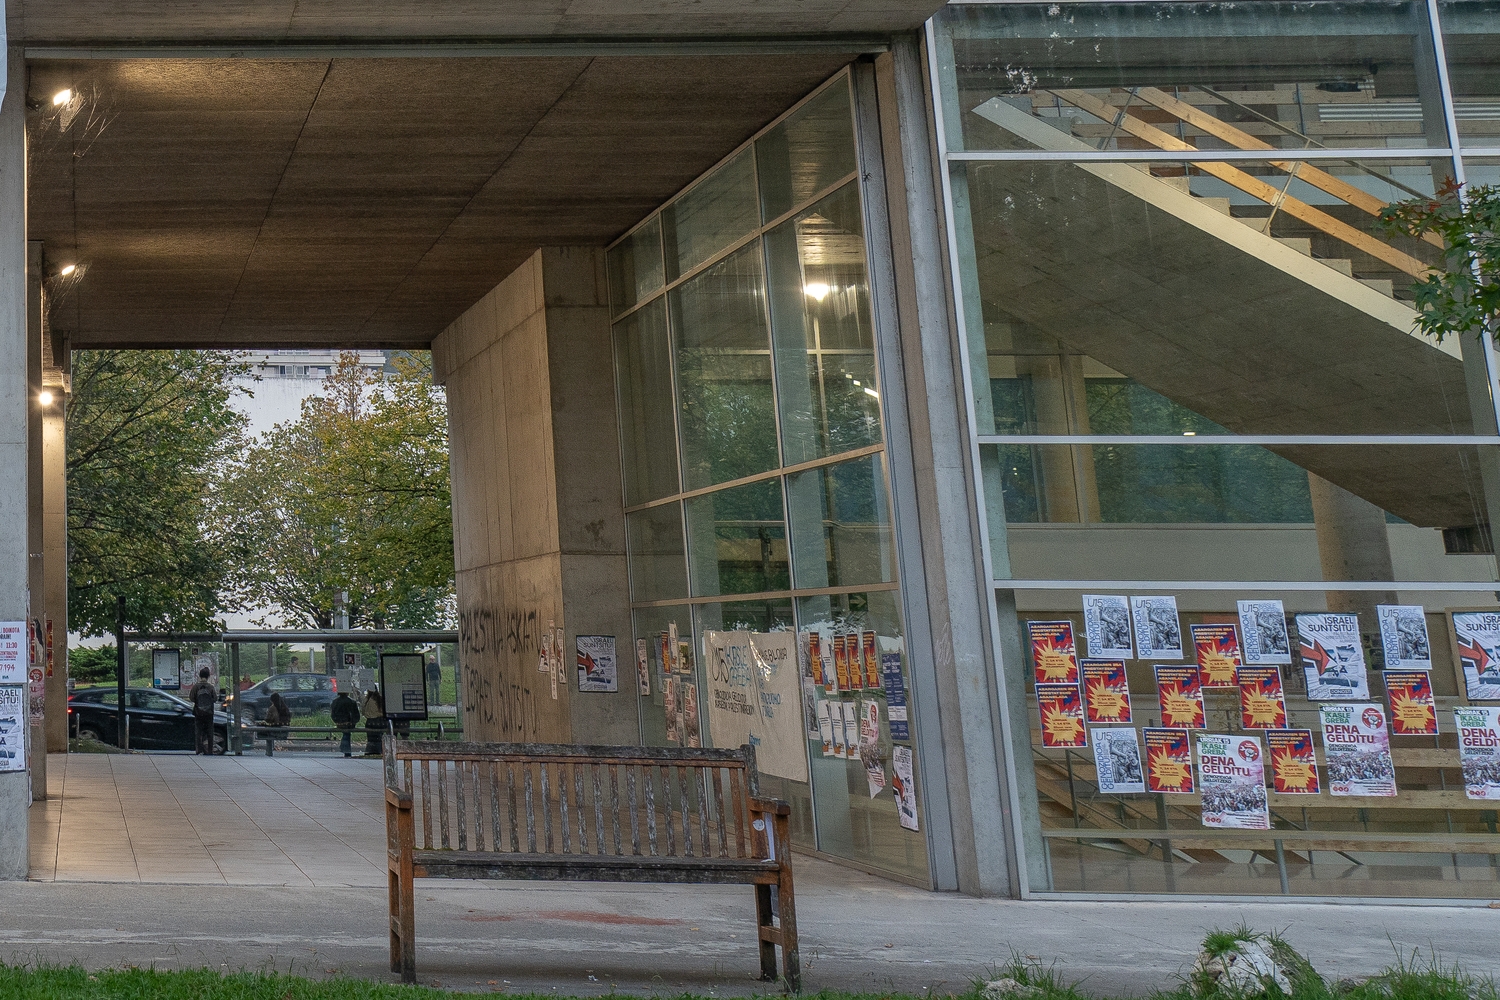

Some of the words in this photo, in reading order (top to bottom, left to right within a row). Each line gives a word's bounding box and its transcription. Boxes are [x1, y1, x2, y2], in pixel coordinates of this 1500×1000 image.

[1087, 599, 1103, 607] U15
[1135, 600, 1152, 609] U15
[1242, 603, 1258, 613] U15
[1382, 609, 1399, 618] U15
[1324, 616, 1354, 624] ISRAEL
[1308, 624, 1355, 632] SUNTSITU!
[1326, 725, 1360, 734] DENA
[1462, 728, 1497, 738] DENA
[1095, 731, 1112, 741] U15
[1327, 734, 1374, 743] GELDITU
[1202, 756, 1235, 766] DENA
[1202, 765, 1250, 776] GELDITU
